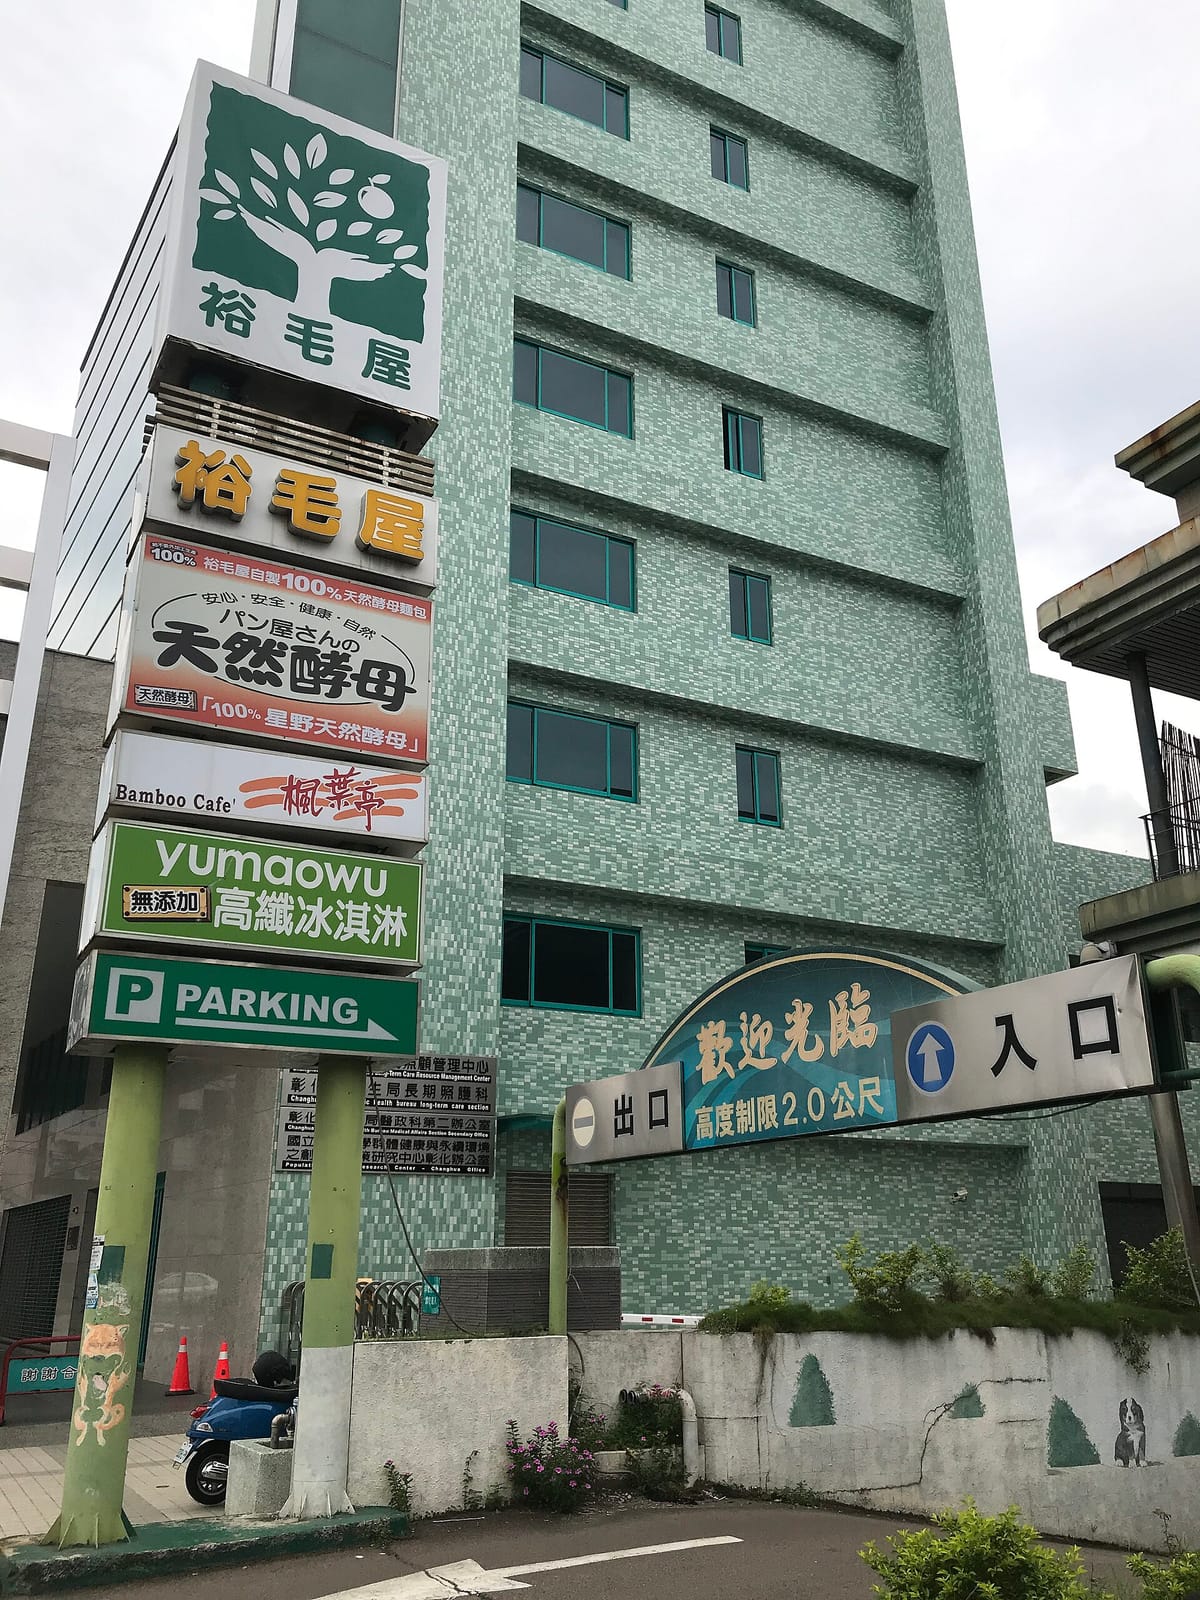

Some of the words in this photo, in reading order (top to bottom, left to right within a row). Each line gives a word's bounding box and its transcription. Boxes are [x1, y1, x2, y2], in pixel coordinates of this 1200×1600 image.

[199, 281, 411, 390] 裕毛屋
[175, 440, 425, 560] 裕毛屋
[151, 547, 197, 566] 100%
[203, 556, 427, 619] 裕毛屋自製100%天然酵母麵包
[219, 608, 360, 652] パン屋さんの
[152, 620, 417, 712] 天然酵母
[139, 688, 190, 705] 天然酵母
[115, 784, 186, 808] Bamboo
[281, 766, 385, 832] 楓葉亭
[155, 839, 388, 897] yumaowu
[131, 890, 200, 913] 無添加
[213, 886, 408, 947] 高纖冰淇淋
[115, 974, 153, 1015] P
[175, 983, 359, 1025] PARKING
[695, 982, 878, 1085] 歡迎光臨
[990, 995, 1120, 1078] 入口
[441, 1073, 472, 1081] Management
[613, 1089, 670, 1138] 出口
[695, 1076, 884, 1141] 高度制限2.0公尺
